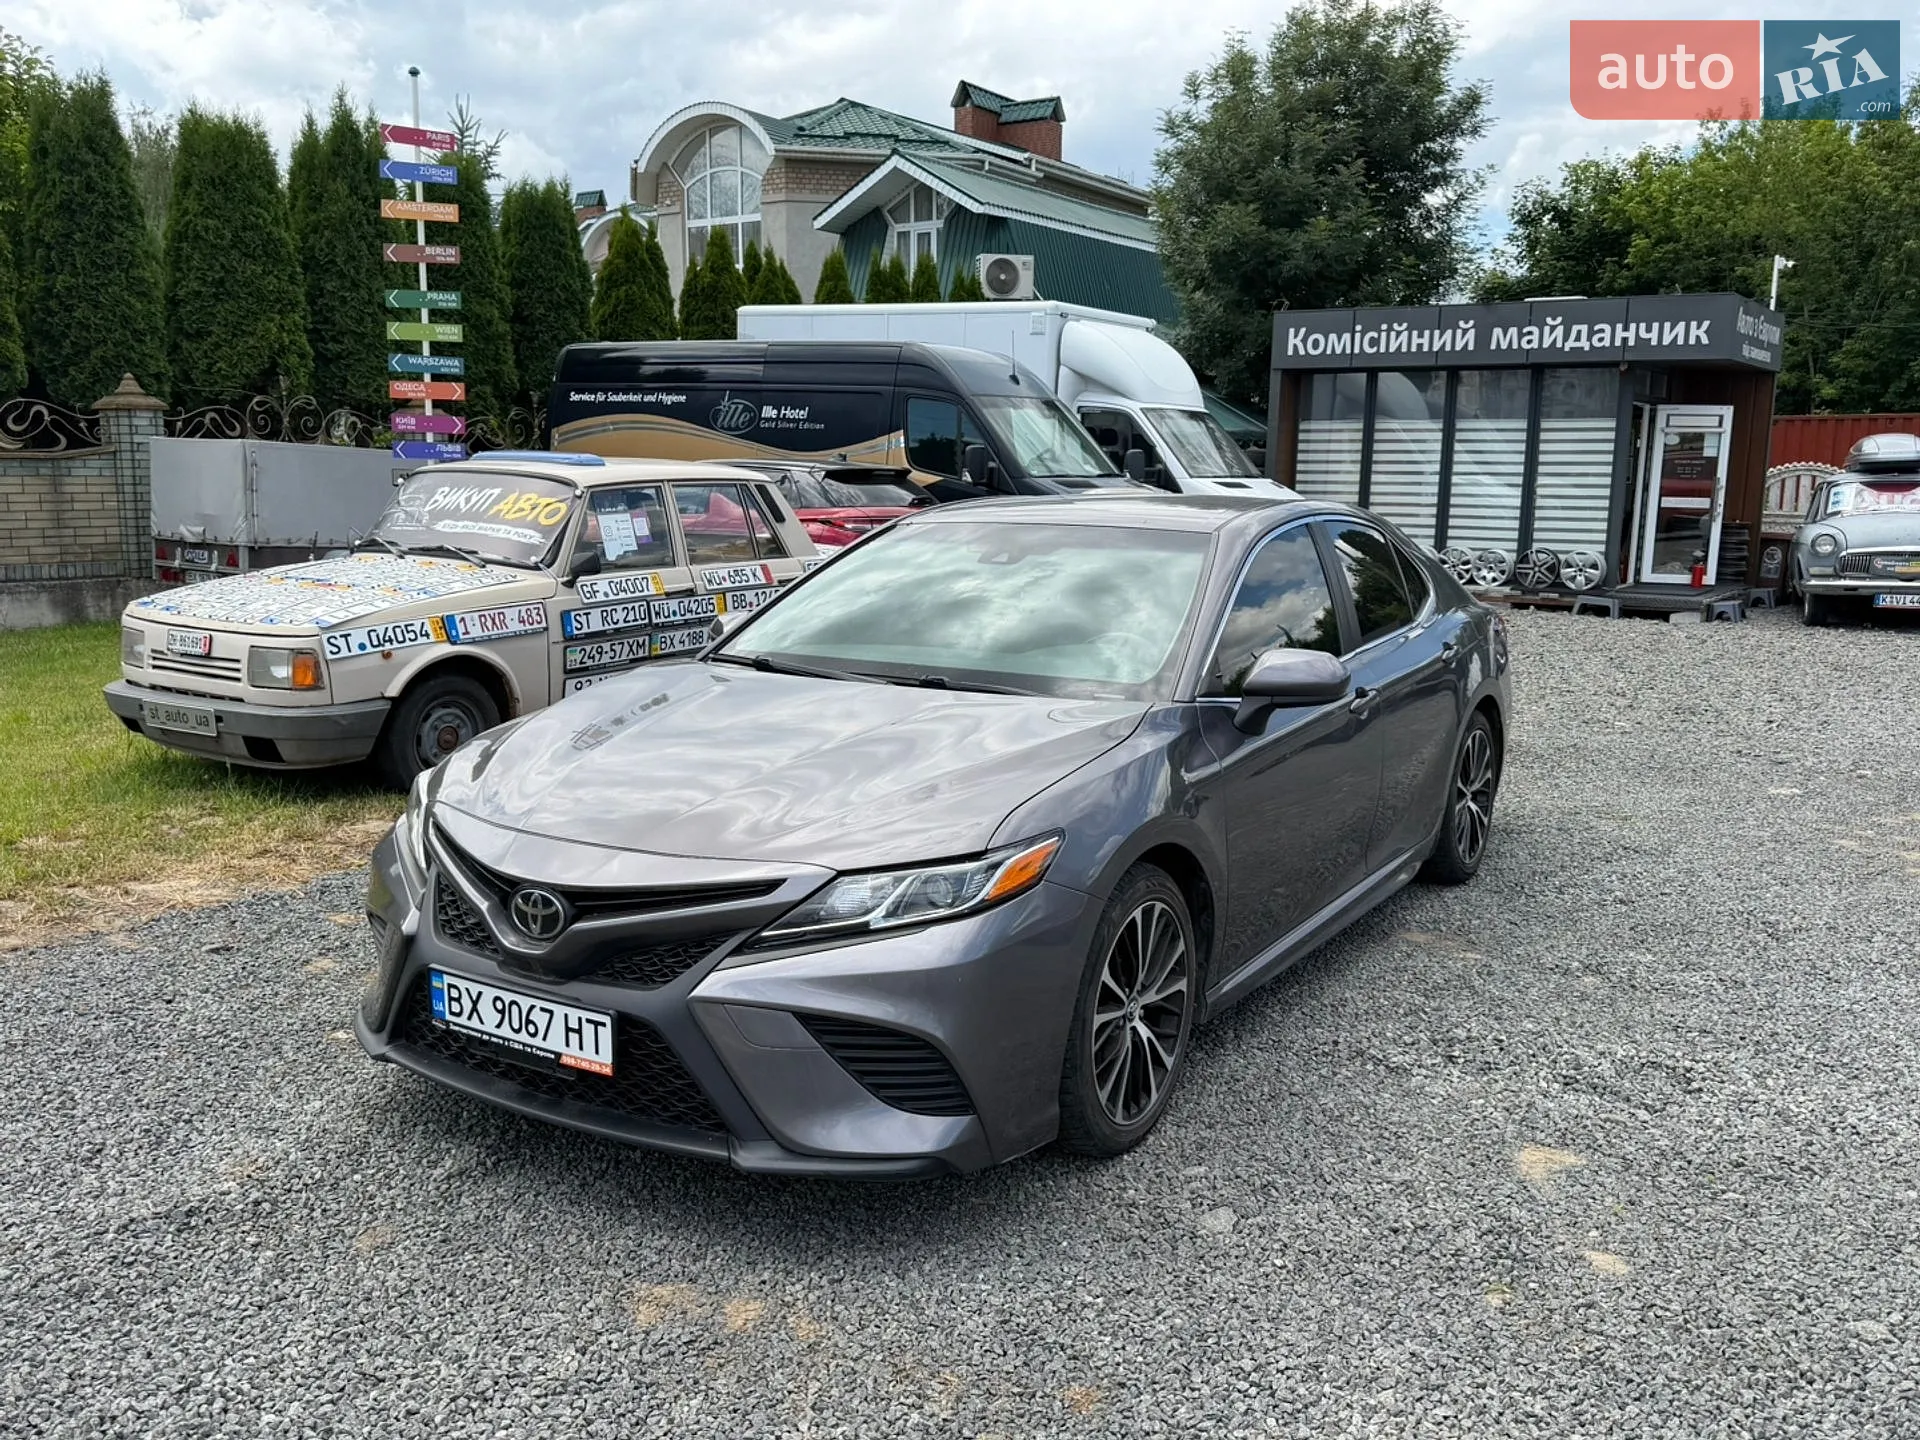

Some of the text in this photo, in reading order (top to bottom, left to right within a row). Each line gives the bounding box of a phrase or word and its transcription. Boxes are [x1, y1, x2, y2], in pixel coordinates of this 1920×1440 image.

[426, 132, 451, 144] PARIS
[419, 166, 454, 178] ZÜRICH
[397, 201, 455, 214] AMSTERDAM
[425, 246, 456, 257] BERLIN
[427, 292, 458, 302] PRAHA
[1737, 305, 1754, 338] Авто
[434, 325, 459, 335] WIEN
[1286, 315, 1711, 357] Комісійний майданчик
[408, 356, 461, 368] WARSZAWA
[393, 382, 426, 392] ОДЕСА
[569, 391, 688, 405] Service für Sauberkeit und Hygiene
[761, 405, 809, 419] Ille Hotel
[396, 416, 417, 427] КИЇВ
[760, 420, 825, 430] Gold Silver Edition
[435, 444, 462, 454] ЛЬВІВ
[425, 486, 569, 526] ВИКУП АВТО
[703, 570, 723, 587] WÜ
[750, 567, 763, 583] K
[580, 582, 600, 600] GF
[731, 593, 749, 611] BB
[653, 597, 717, 623] WÜ 04205
[478, 611, 509, 633] RXR
[517, 606, 544, 628] 483
[573, 603, 648, 632] ST RC 210
[327, 633, 353, 656] ST
[660, 634, 676, 652] BX
[433, 982, 608, 1057] UA BX 9067 HT
